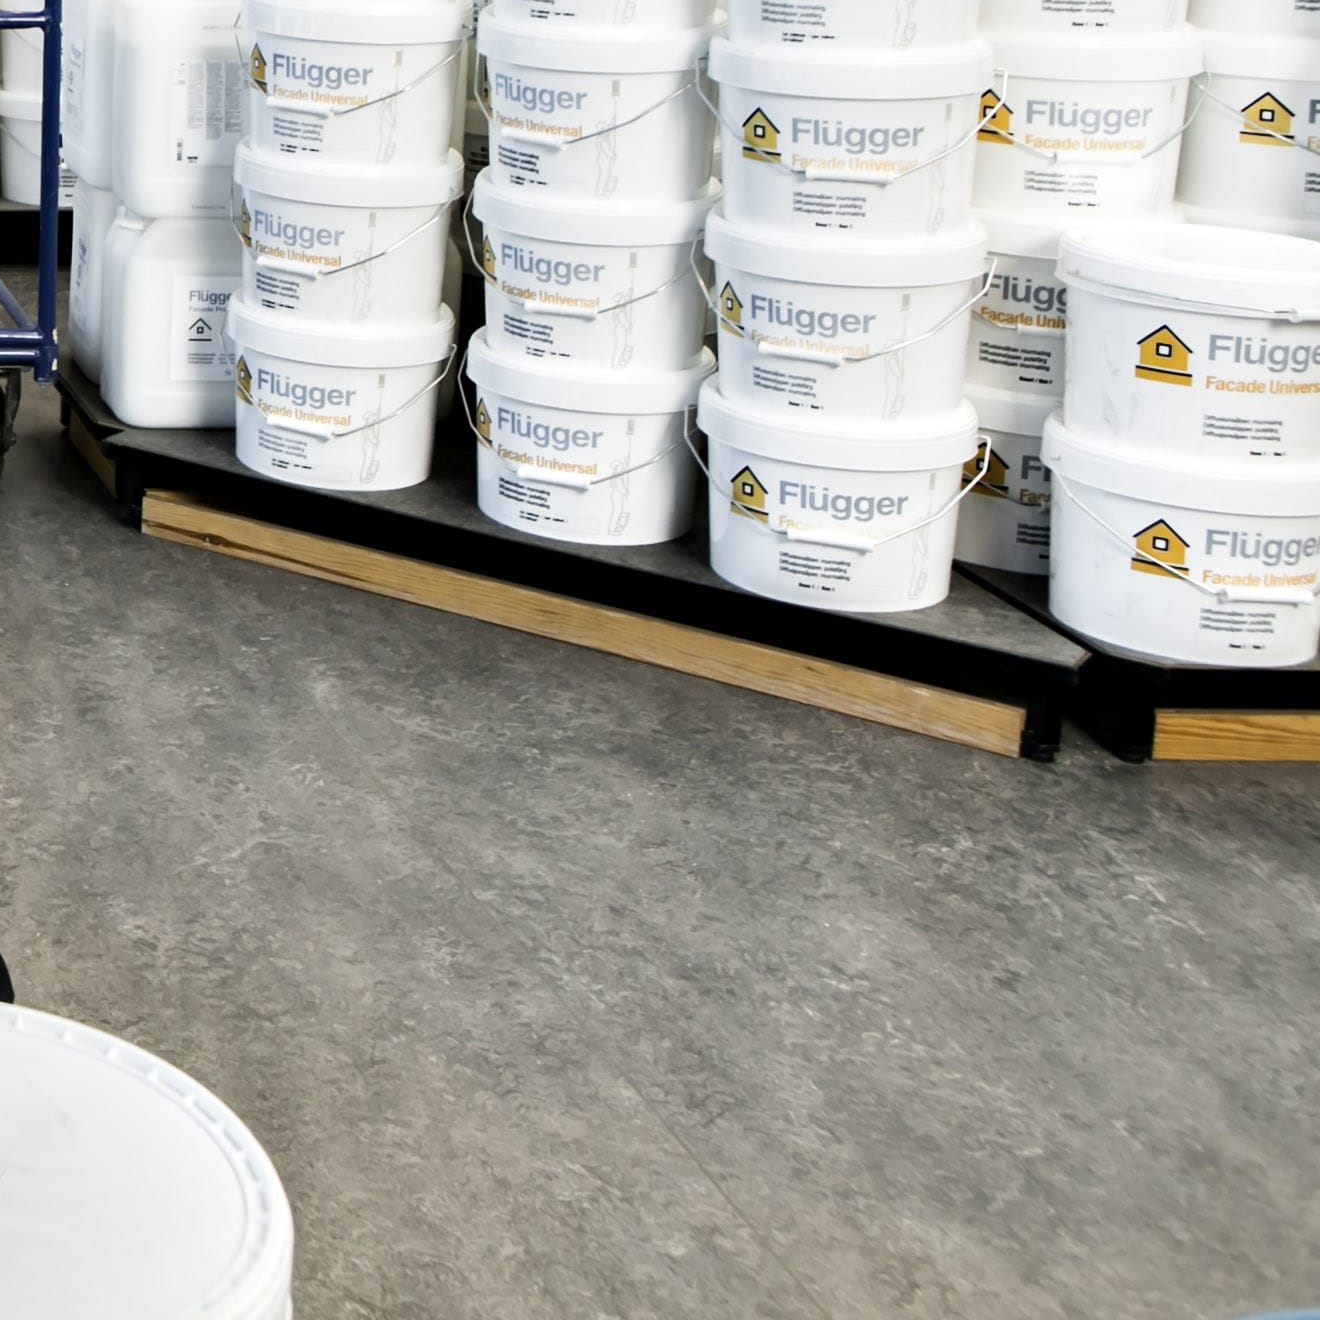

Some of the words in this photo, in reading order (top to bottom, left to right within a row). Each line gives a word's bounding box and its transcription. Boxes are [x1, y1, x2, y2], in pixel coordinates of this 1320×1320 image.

[272, 53, 373, 90] Flügger
[311, 92, 368, 108] Universal
[495, 72, 588, 114] Flügger
[526, 119, 583, 138] Universal
[1026, 100, 1154, 135] Flügger
[791, 117, 925, 156] Flügger
[1024, 134, 1080, 152] Facade
[1082, 136, 1146, 151] Universal
[253, 209, 346, 249] Flügger
[287, 249, 342, 267] Universal
[501, 242, 606, 284] Flügger
[539, 289, 600, 309] Universal
[750, 294, 877, 338] Flügger
[981, 306, 1033, 325] Facade
[1208, 335, 1320, 373] Flügge
[258, 368, 356, 409] Flügger
[1206, 376, 1266, 393] Facade
[1270, 381, 1320, 394] Univers
[294, 408, 351, 427] Universal
[497, 406, 603, 452] Flügger
[497, 444, 535, 465] Facade
[536, 455, 598, 476] Universal
[779, 480, 909, 521] Flügger
[1202, 569, 1260, 587] Facade
